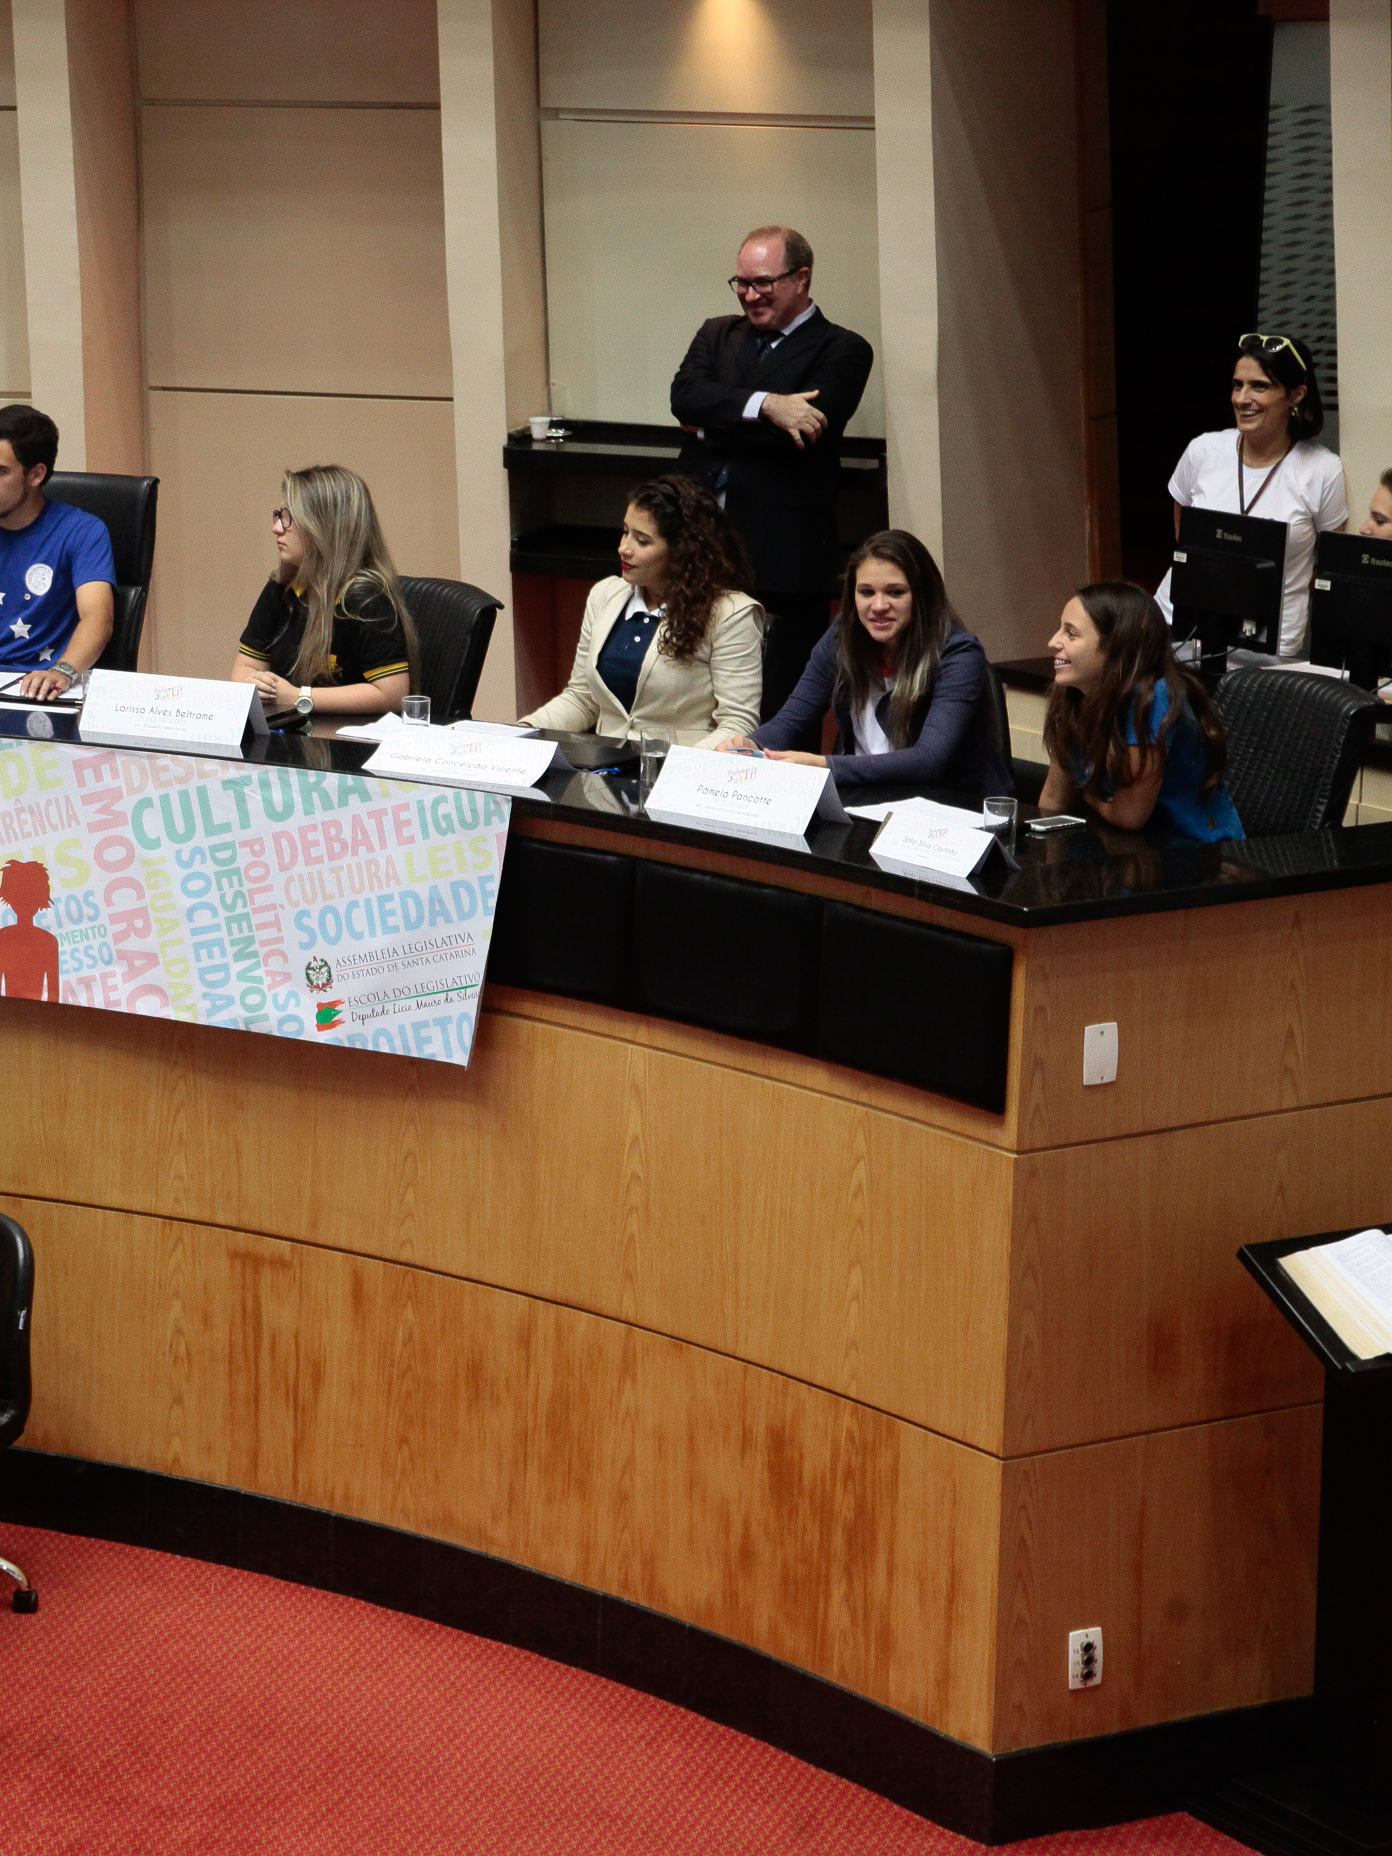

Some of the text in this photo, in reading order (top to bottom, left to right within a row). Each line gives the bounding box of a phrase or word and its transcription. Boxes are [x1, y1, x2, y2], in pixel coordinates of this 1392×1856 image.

[114, 703, 214, 721] Larissa Alves Beltrame
[389, 752, 432, 764] Gabriela
[491, 764, 527, 775] Vicente
[131, 768, 373, 850] CULTURA
[731, 790, 773, 806] Pancotte
[272, 803, 416, 872] DEBATE
[404, 835, 493, 884] LEIS
[283, 854, 402, 908] CULTURA
[238, 837, 293, 991] POLÍTICA
[293, 874, 496, 950] SOCIEDADE
[335, 931, 475, 969] ASSEMBLEIA LEGISLATIVA
[336, 947, 477, 983] DO ESTADO DE SANTA CATARINA
[347, 971, 481, 1008] ESCOLA DO LEGISLATIVO
[351, 1004, 390, 1026] Deputado
[443, 994, 456, 1005] da
